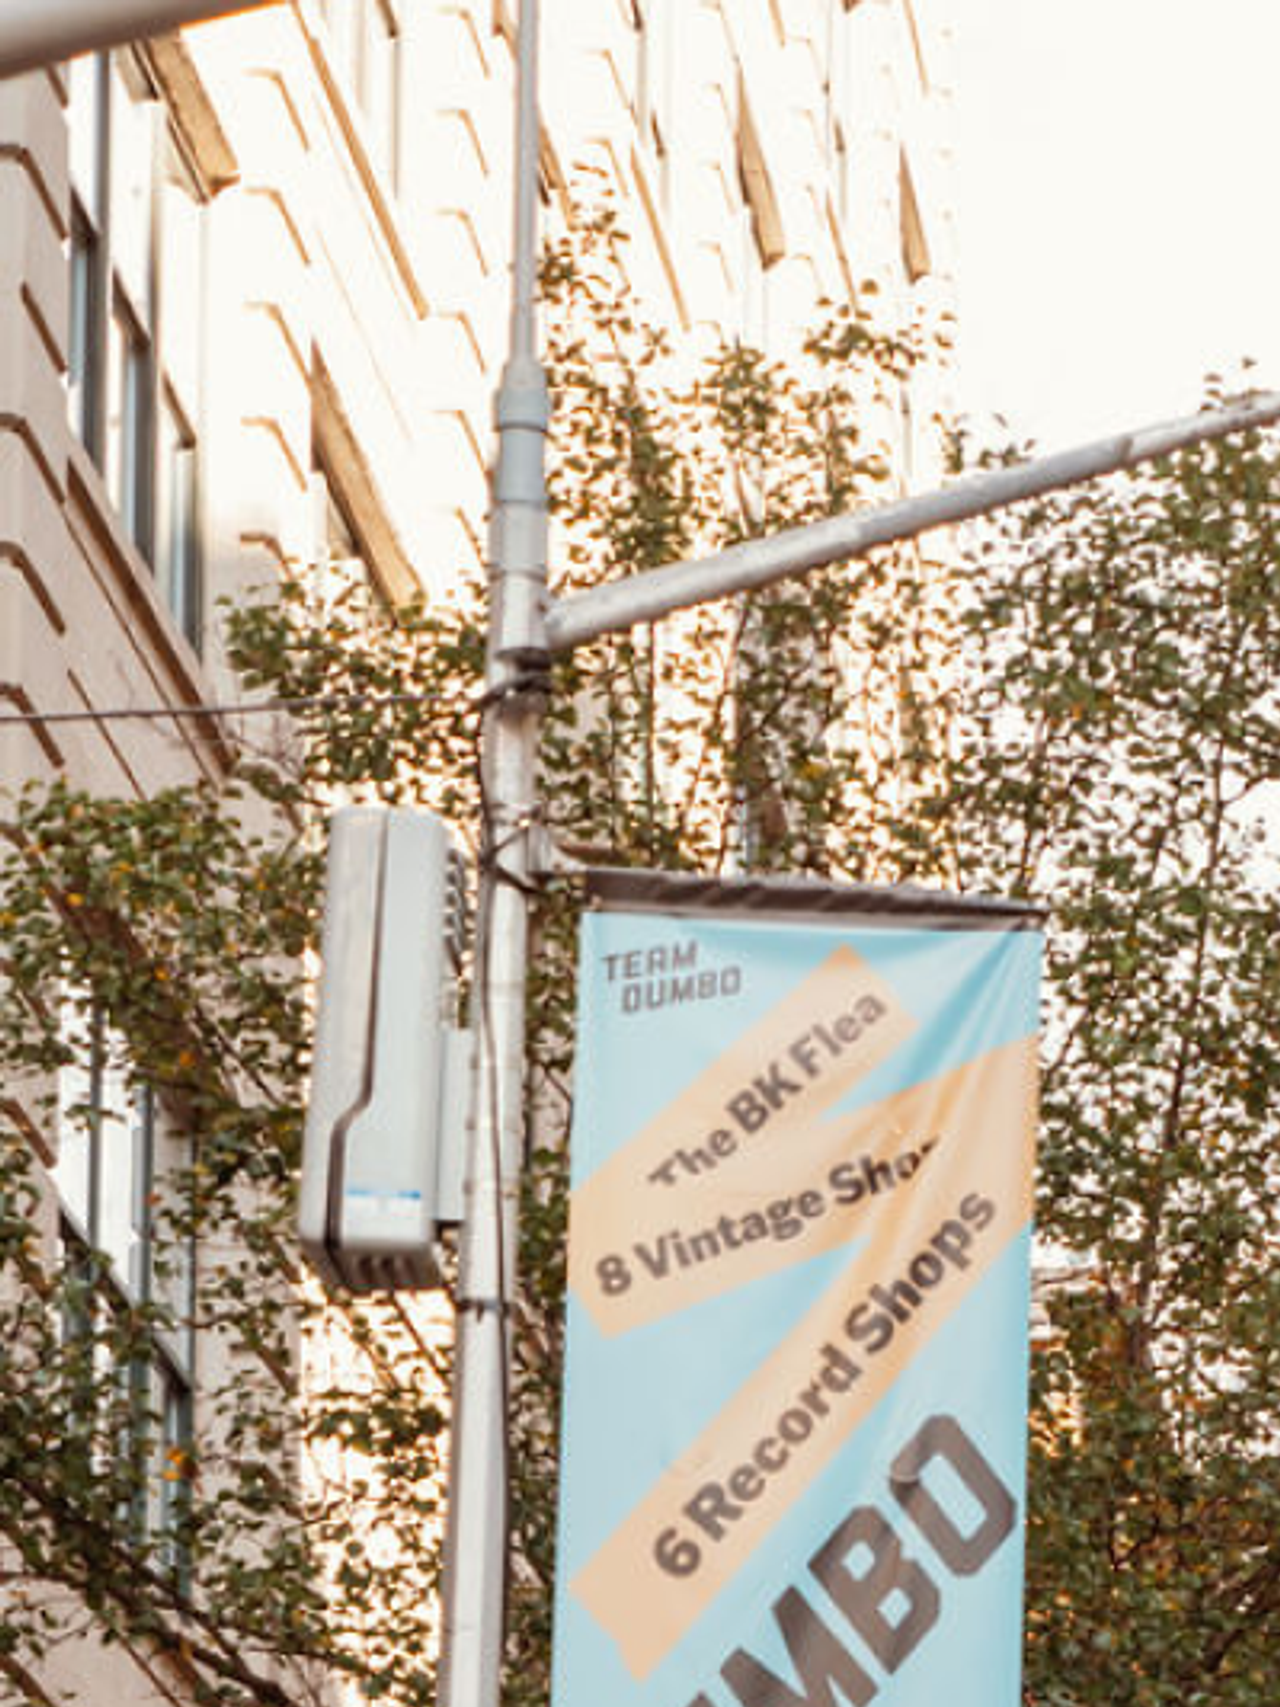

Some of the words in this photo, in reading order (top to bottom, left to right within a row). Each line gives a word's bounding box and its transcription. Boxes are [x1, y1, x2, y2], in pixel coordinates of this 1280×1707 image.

[602, 940, 698, 982] TEAM
[621, 965, 742, 1014] DUMBO
[648, 1129, 738, 1186] The
[725, 1061, 804, 1135] BK
[788, 994, 888, 1080] Flea
[595, 1255, 633, 1297] 8
[633, 1188, 827, 1281] Vintage
[828, 1136, 938, 1206] Sho
[653, 1525, 702, 1580] 6
[682, 1342, 864, 1544] Record
[843, 1192, 998, 1356] Shops
